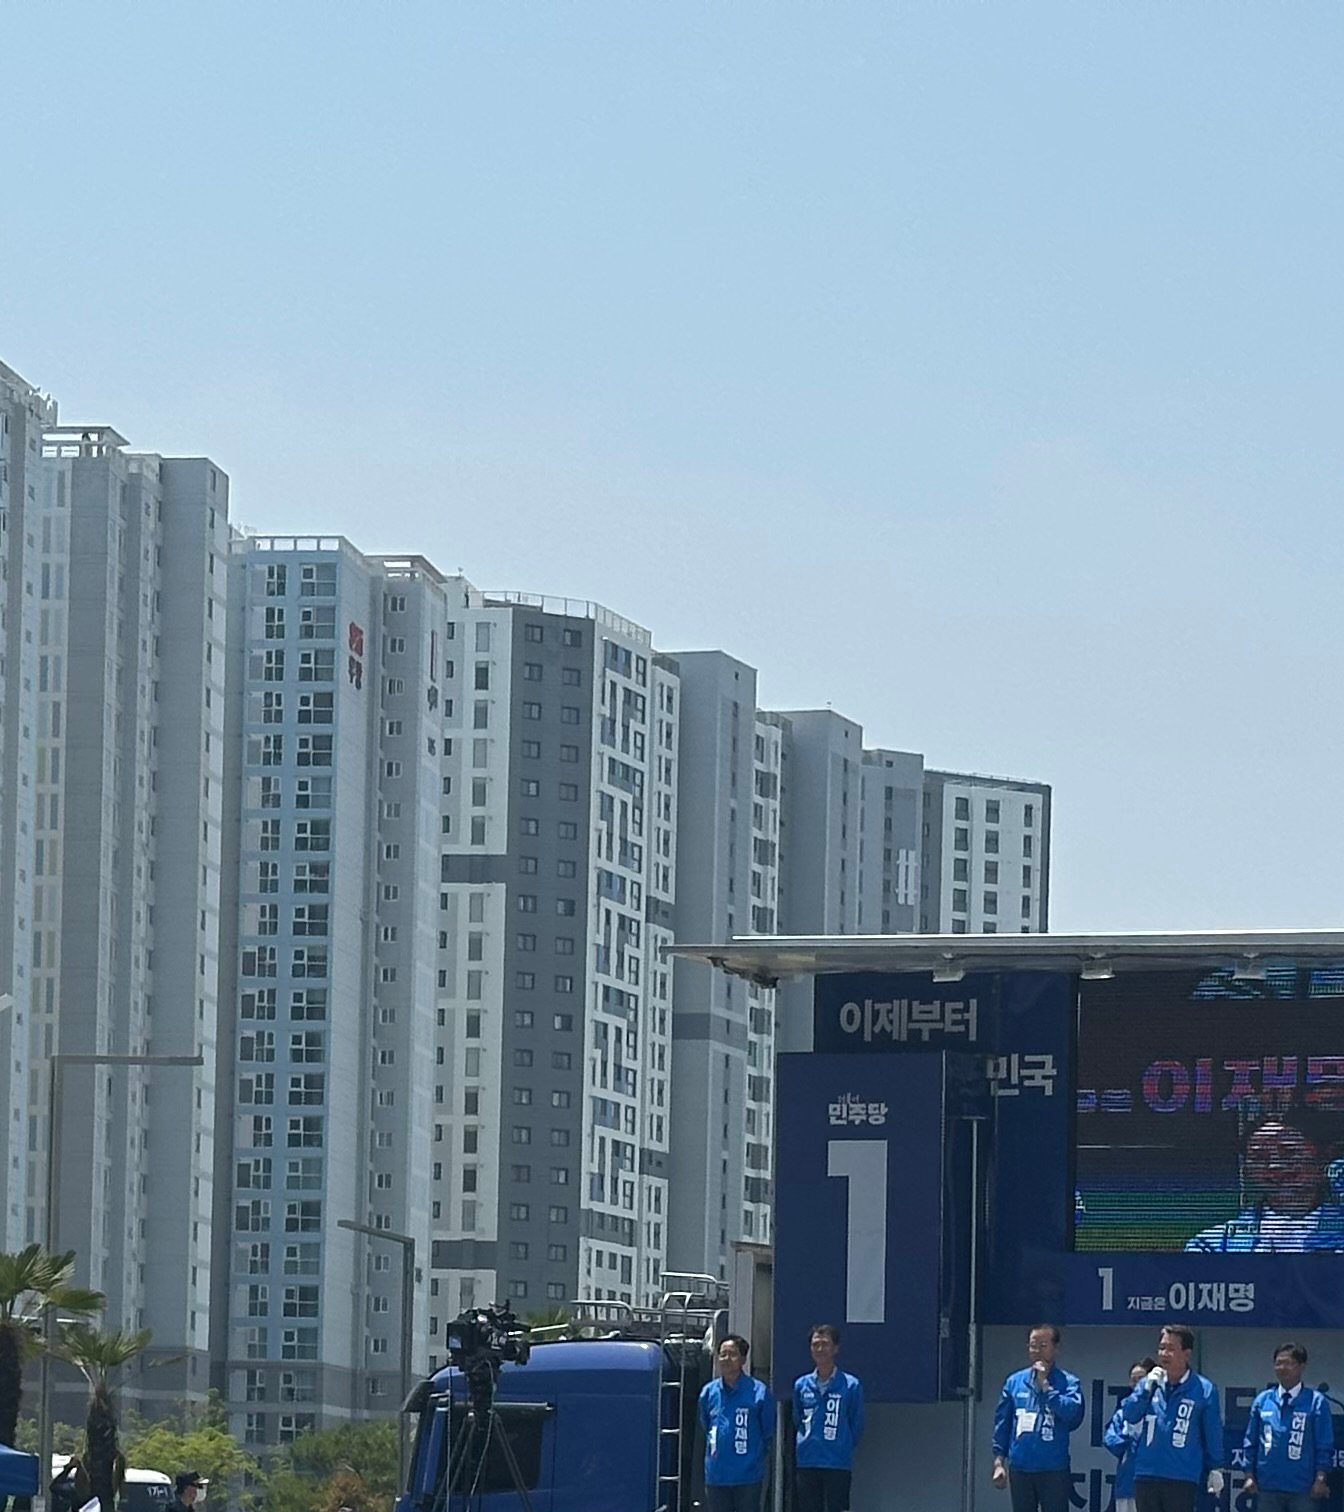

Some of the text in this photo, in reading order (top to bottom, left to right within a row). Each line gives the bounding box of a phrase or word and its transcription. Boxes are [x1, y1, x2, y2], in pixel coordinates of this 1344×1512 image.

[840, 999, 977, 1042] 이제부터
[828, 1103, 888, 1125] 민주당
[827, 1139, 887, 1323] 1
[1098, 1268, 1113, 1311] 1
[1127, 1282, 1255, 1312] 지금은 이재명
